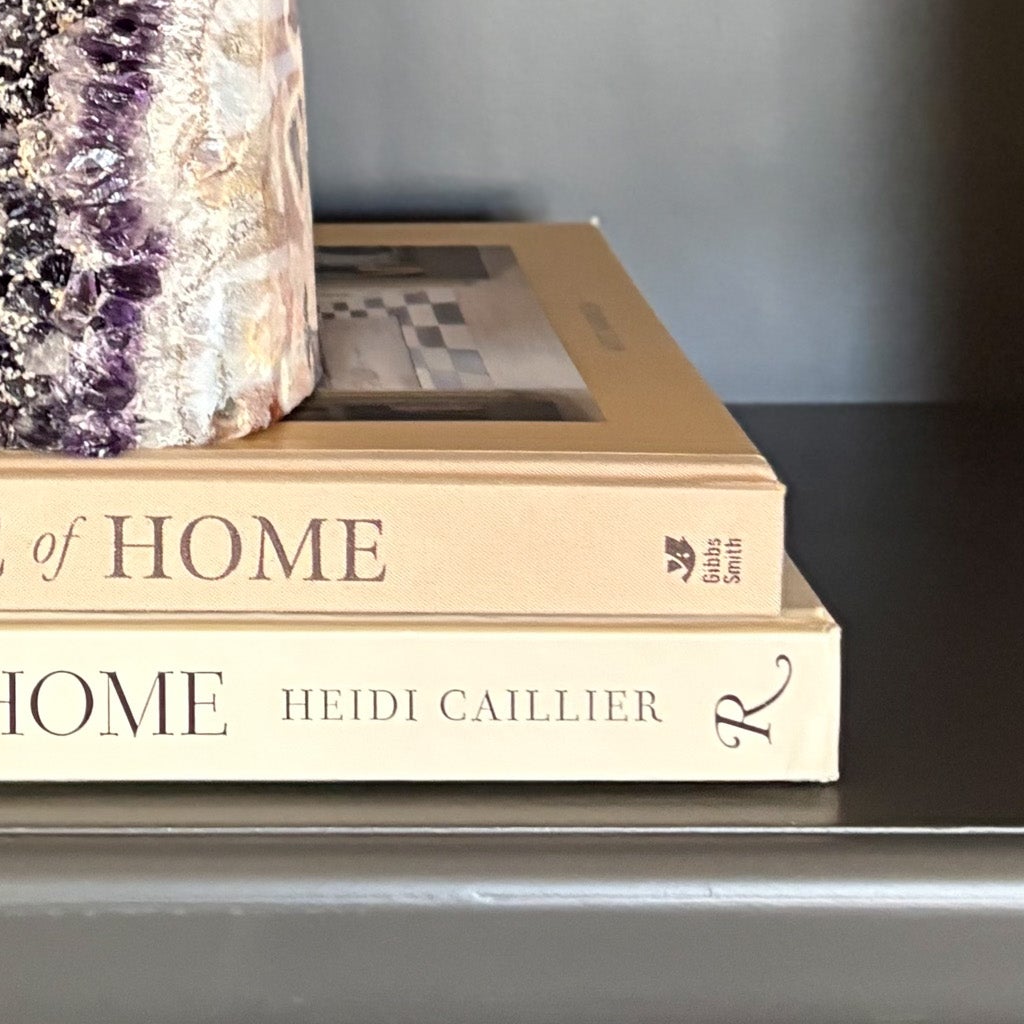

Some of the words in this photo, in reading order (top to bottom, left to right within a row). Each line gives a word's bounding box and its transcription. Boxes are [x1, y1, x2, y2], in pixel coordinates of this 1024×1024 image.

[32, 515, 87, 582] of
[104, 514, 387, 582] HOME
[702, 537, 722, 585] Gibbs
[723, 537, 742, 584] Smith
[281, 688, 418, 722] HEIDI
[439, 688, 664, 723] CAILLIER
[714, 654, 793, 750] R
